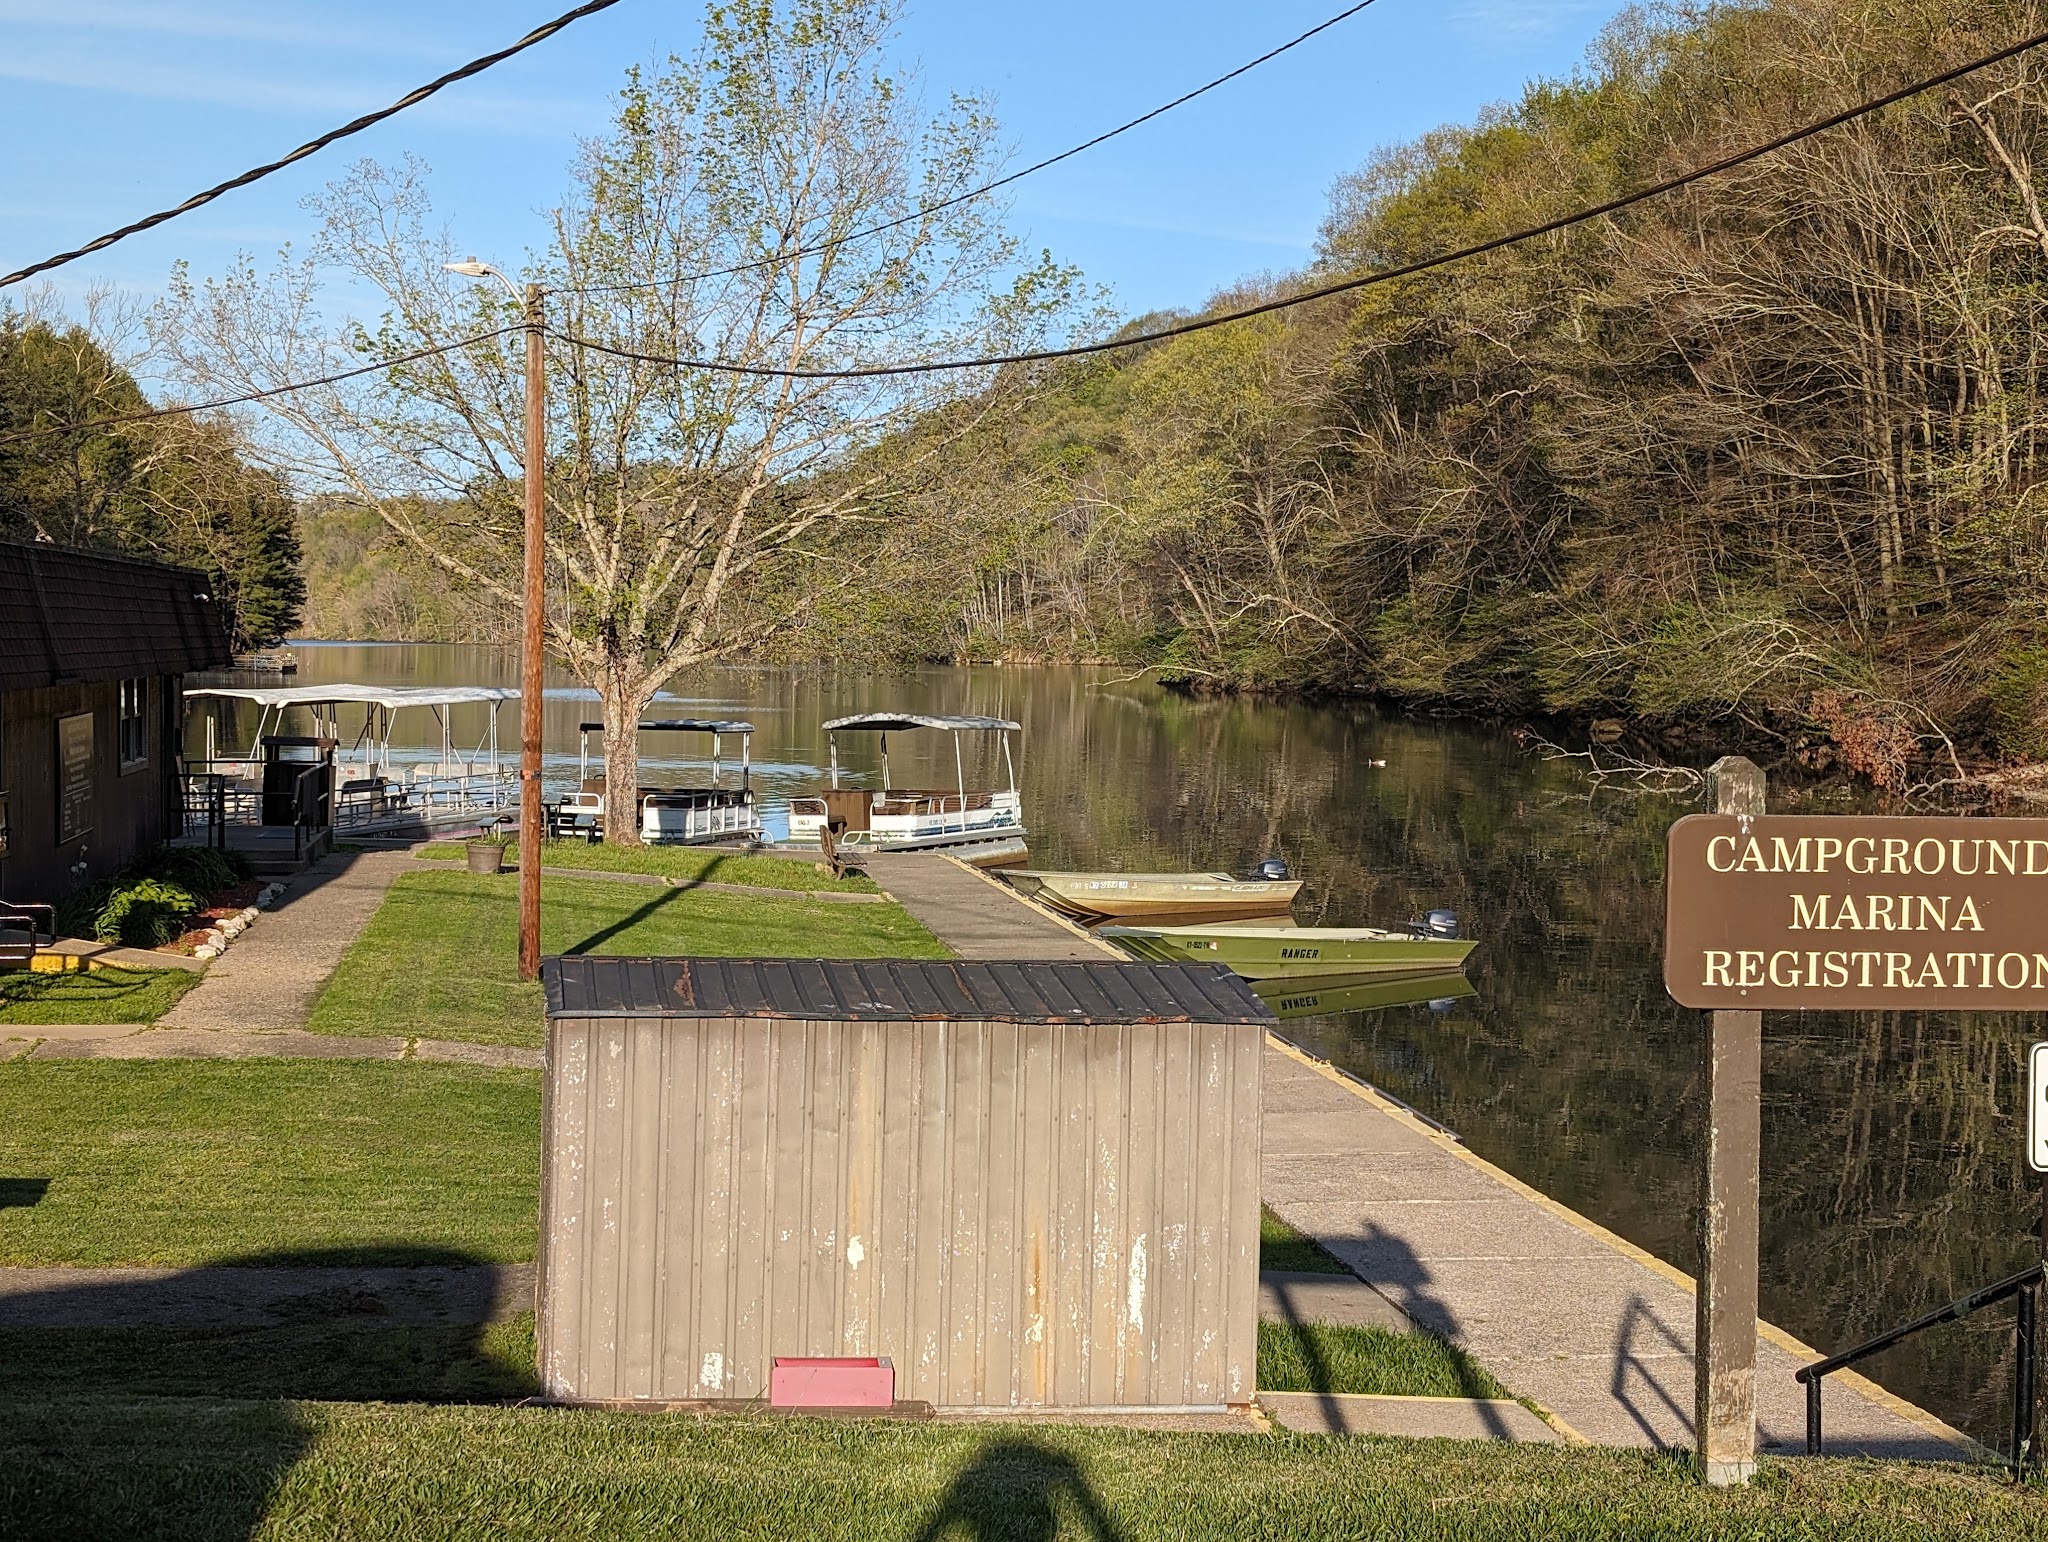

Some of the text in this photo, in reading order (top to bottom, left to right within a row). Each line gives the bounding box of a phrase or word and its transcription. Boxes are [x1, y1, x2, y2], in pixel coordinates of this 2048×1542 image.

[1706, 835, 2048, 876] CAMPGROUND
[1788, 894, 1985, 931] MARINA
[1281, 948, 1319, 959] RANGER
